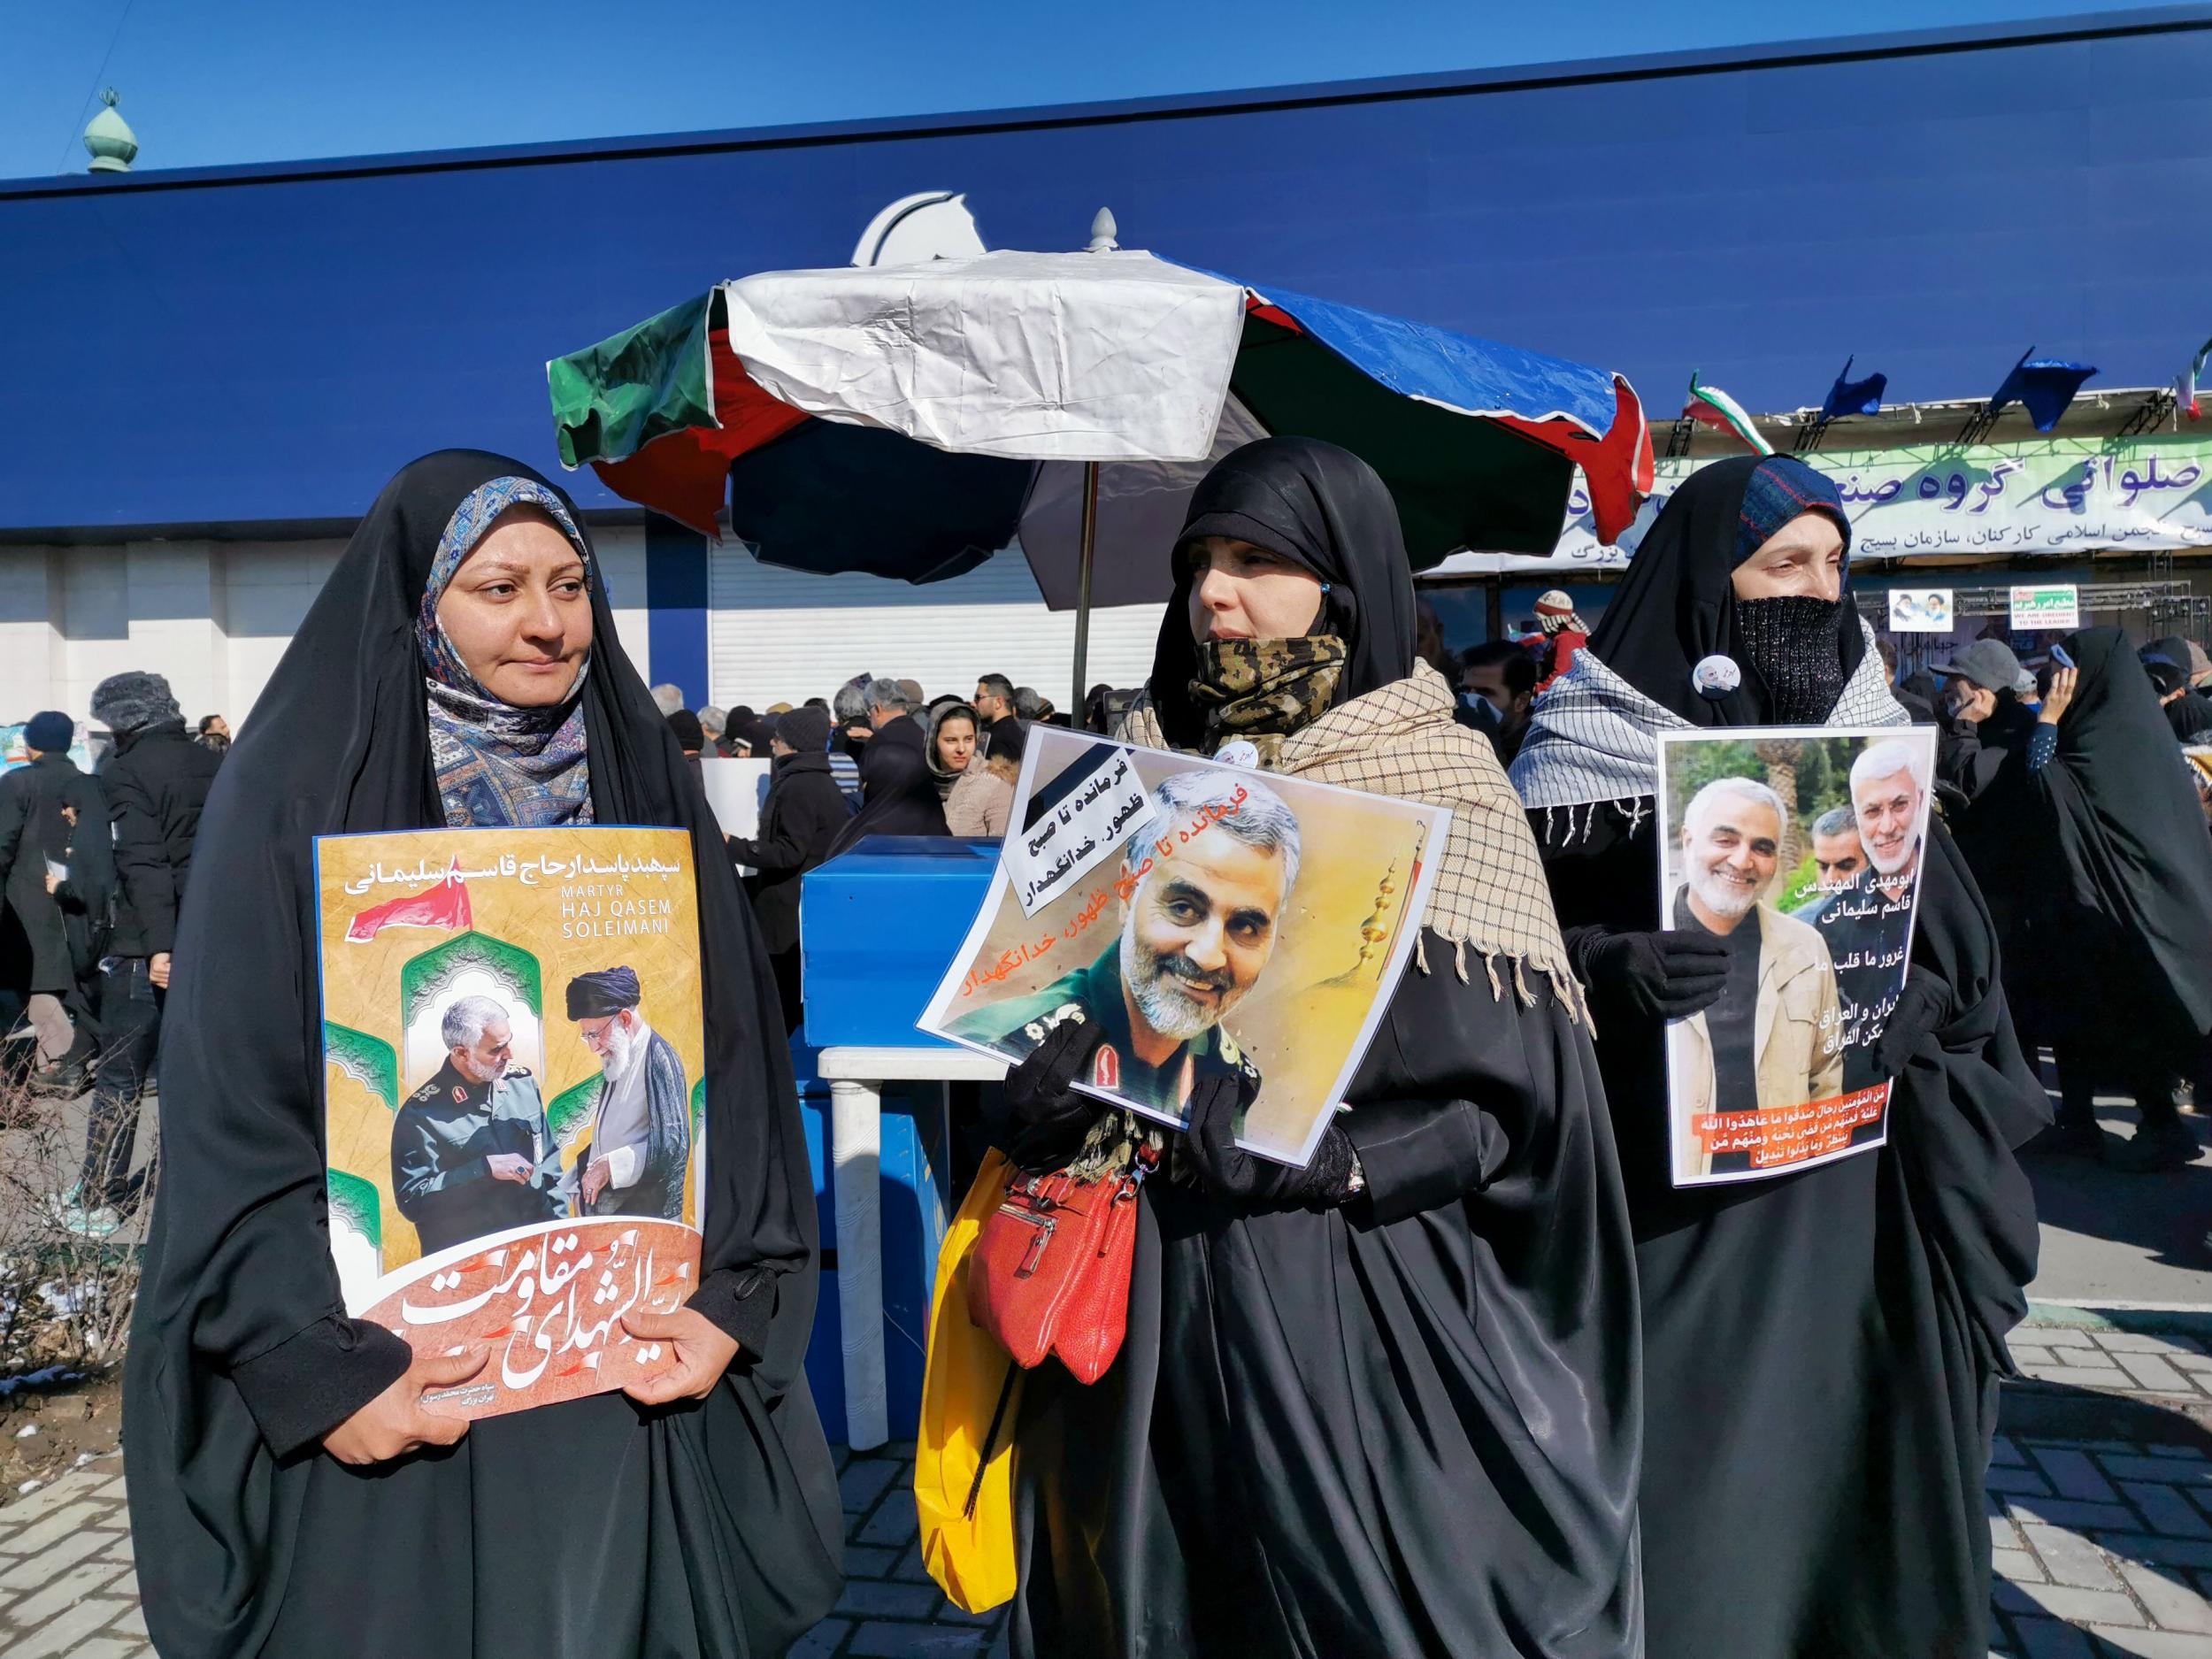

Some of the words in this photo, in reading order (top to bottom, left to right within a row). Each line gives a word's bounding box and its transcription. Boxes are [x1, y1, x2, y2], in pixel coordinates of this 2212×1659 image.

[1839, 474, 1903, 505] صنع
[1917, 456, 2027, 515] گروه
[2040, 452, 2202, 511] صلواتی
[1860, 535, 1897, 554] بسیج
[1903, 528, 1960, 549] سازمان
[2047, 524, 2106, 546] اسلامی
[1075, 758, 1128, 812] فرمانده
[1057, 804, 1071, 826] تا
[1179, 782, 1249, 843] فرمانده
[1028, 821, 1056, 856] صبح
[1155, 835, 1173, 857] تا
[344, 858, 449, 895] سلیمانی
[444, 854, 517, 888] قاسم
[518, 854, 567, 885] حاج
[565, 853, 630, 883] پاسدار
[631, 856, 680, 882] سپهبد
[1026, 835, 1096, 907] خدانگهدار
[1113, 857, 1154, 901] صبح
[561, 885, 624, 898] MARTYR
[1794, 872, 1860, 899] المهندس
[562, 901, 602, 918] HAJ
[611, 899, 672, 918] QASEM
[1821, 898, 1878, 924] سلیمانی
[1881, 894, 1911, 919] قاسم
[562, 918, 669, 939] SOLEIMANI
[963, 933, 1057, 997] خدانگهدار
[1833, 951, 1860, 974] قلب
[1864, 949, 1877, 966] ما
[1878, 946, 1904, 969] غرور
[1818, 1002, 1859, 1029] العراق
[1861, 1007, 1869, 1021] و
[1823, 1027, 1860, 1055] الفراق
[402, 1231, 594, 1325] مقاومت
